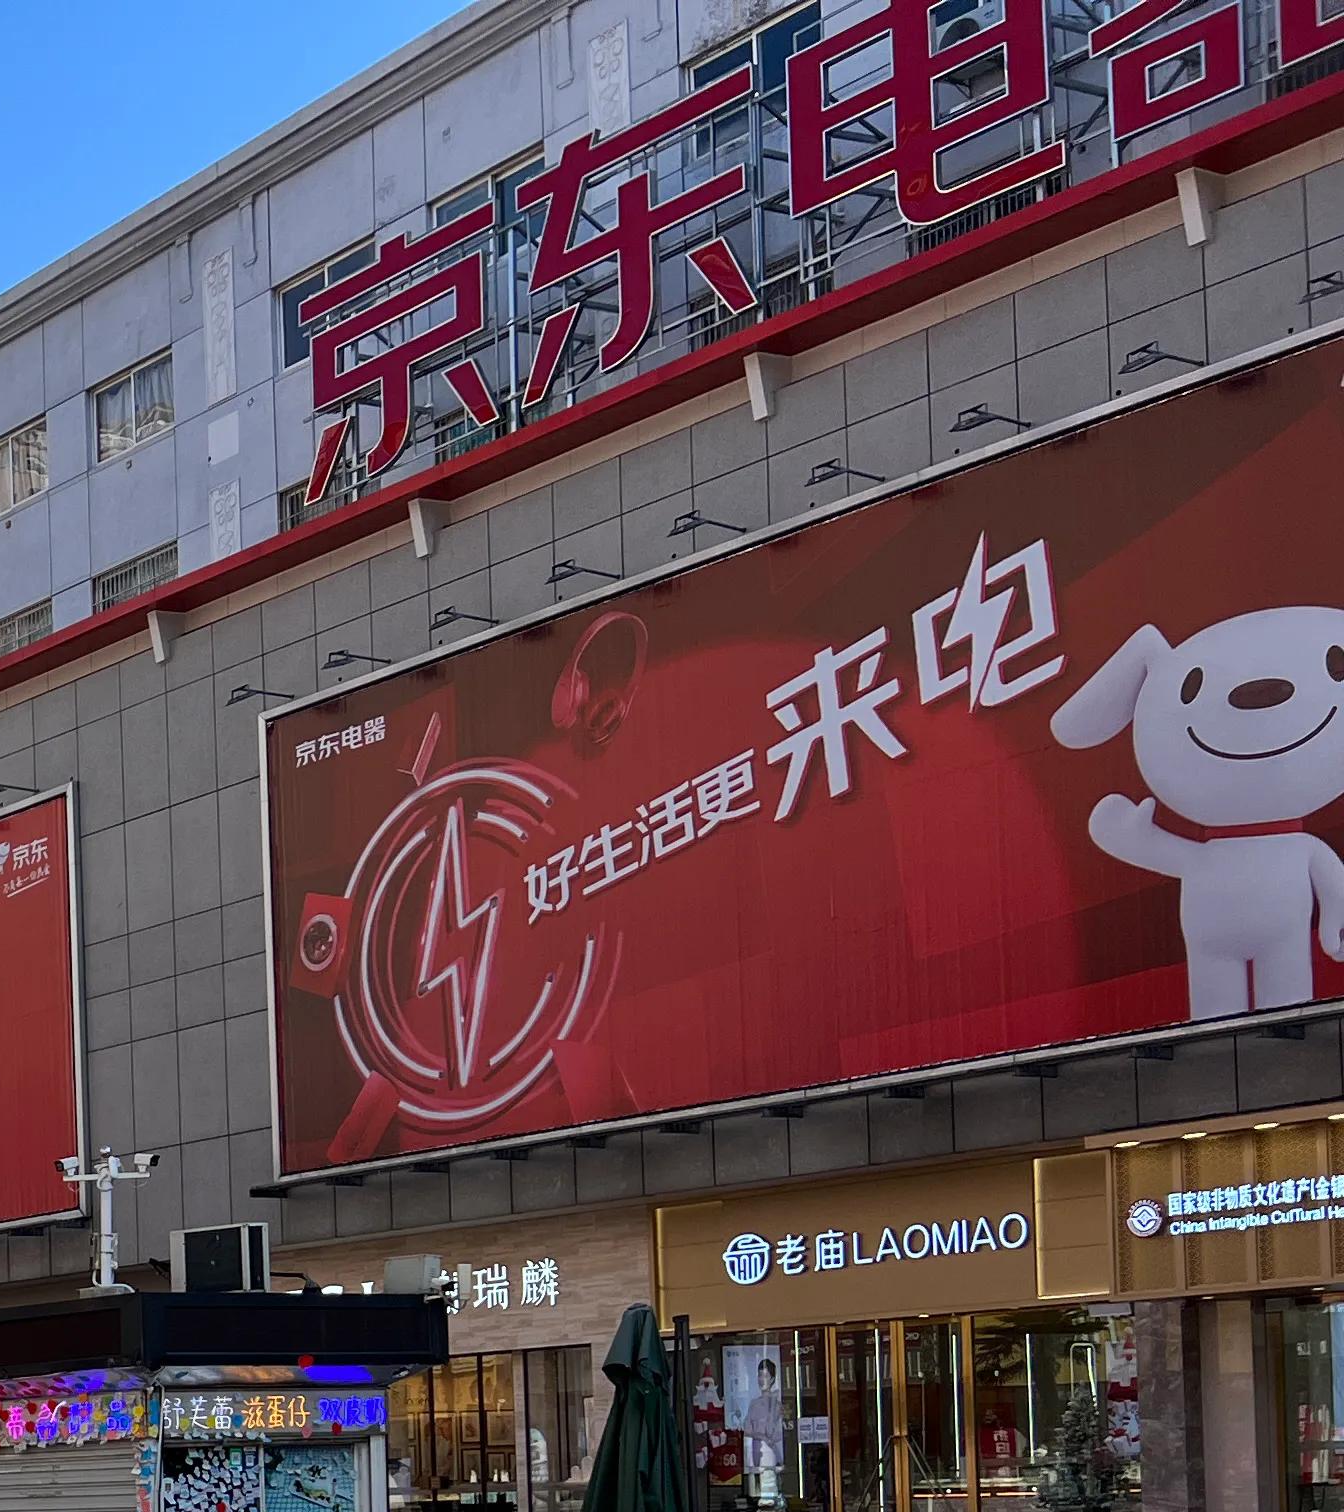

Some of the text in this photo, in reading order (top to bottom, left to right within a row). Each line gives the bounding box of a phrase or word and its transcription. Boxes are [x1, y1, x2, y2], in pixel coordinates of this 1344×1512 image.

[294, 714, 387, 769] 京东电器
[524, 530, 1068, 925] 好生活更来电
[12, 837, 49, 871] 京东
[776, 1213, 1029, 1275] 老庙 LAOMIAO
[1169, 1221, 1207, 1236] China
[1209, 1213, 1268, 1232] Intangible
[163, 1395, 233, 1429] 舒芙蕾
[319, 1396, 386, 1428] 双皮奶
